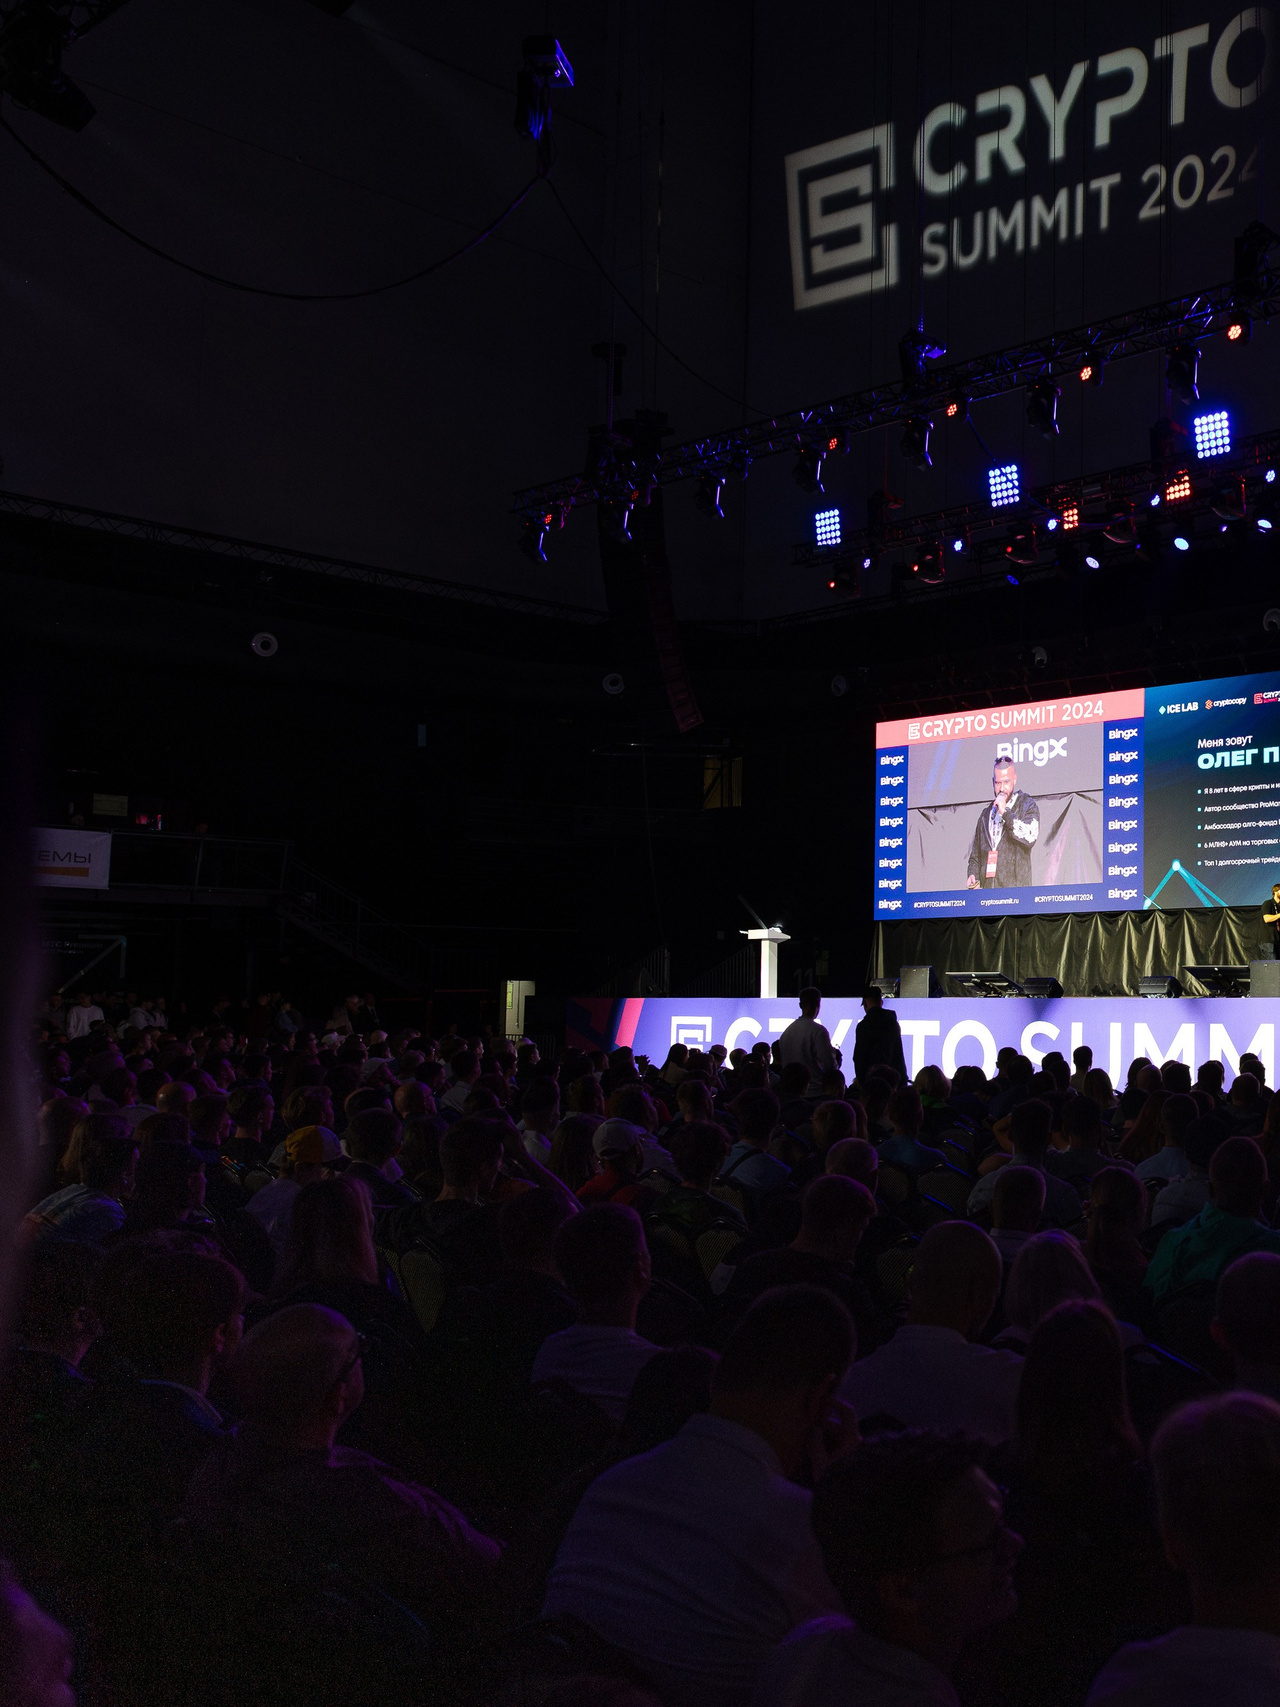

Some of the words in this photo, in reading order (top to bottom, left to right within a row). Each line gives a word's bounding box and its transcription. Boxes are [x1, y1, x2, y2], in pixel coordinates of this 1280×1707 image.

[914, 6, 1275, 195] CRYPTO
[921, 172, 1122, 278] SUMMIT
[1167, 704, 1180, 714] ICE
[1182, 702, 1198, 712] LAB
[1213, 698, 1246, 707] cryptocopy
[923, 715, 987, 737] CRYPTO
[990, 705, 1057, 729] SUMMIT
[1062, 700, 1103, 721] 2024
[1198, 737, 1223, 749] Меня
[1226, 735, 1252, 747] зовут
[1197, 749, 1258, 770] ОЛЕГ
[37, 850, 92, 864] ЕМЫ
[724, 1016, 998, 1084] CTO
